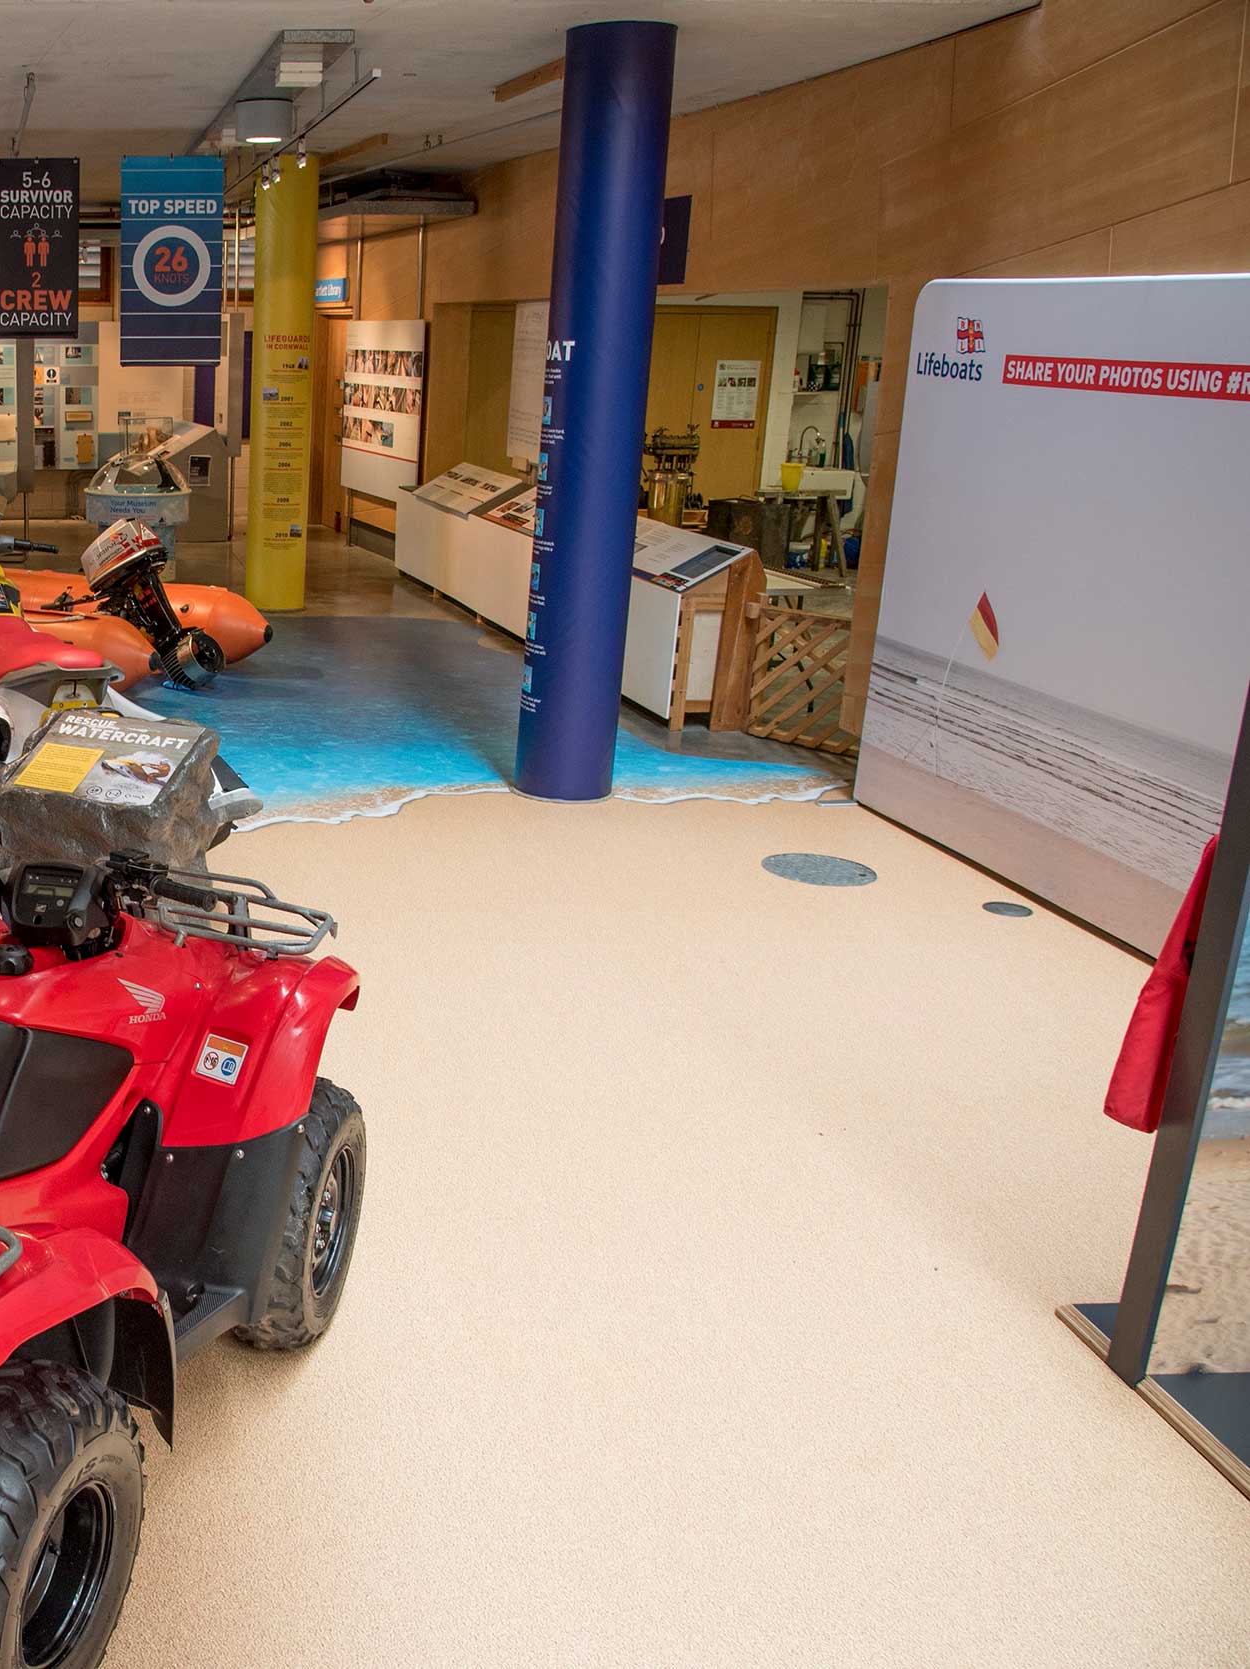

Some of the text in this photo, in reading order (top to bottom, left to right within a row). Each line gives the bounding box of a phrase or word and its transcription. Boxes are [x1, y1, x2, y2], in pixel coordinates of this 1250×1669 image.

[22, 171, 51, 189] 5-6
[0, 190, 73, 204] SURVIVOR
[0, 204, 73, 220] CAPACITY
[128, 199, 217, 215] TOP SPEED
[154, 247, 188, 273] 26
[31, 271, 42, 288] 2
[154, 272, 190, 284] KNOTS
[0, 290, 72, 311] CREW
[0, 312, 72, 327] CAPACITY
[916, 352, 983, 382] Lifeboats
[1006, 360, 1054, 382] SHARE
[1057, 363, 1096, 384] YOUR
[1100, 365, 1163, 390] PHOTOS
[1166, 368, 1223, 393] USING
[65, 715, 117, 728] RESCUE
[58, 723, 189, 750] WATERCRAFT
[128, 1011, 167, 1025] HONDA
